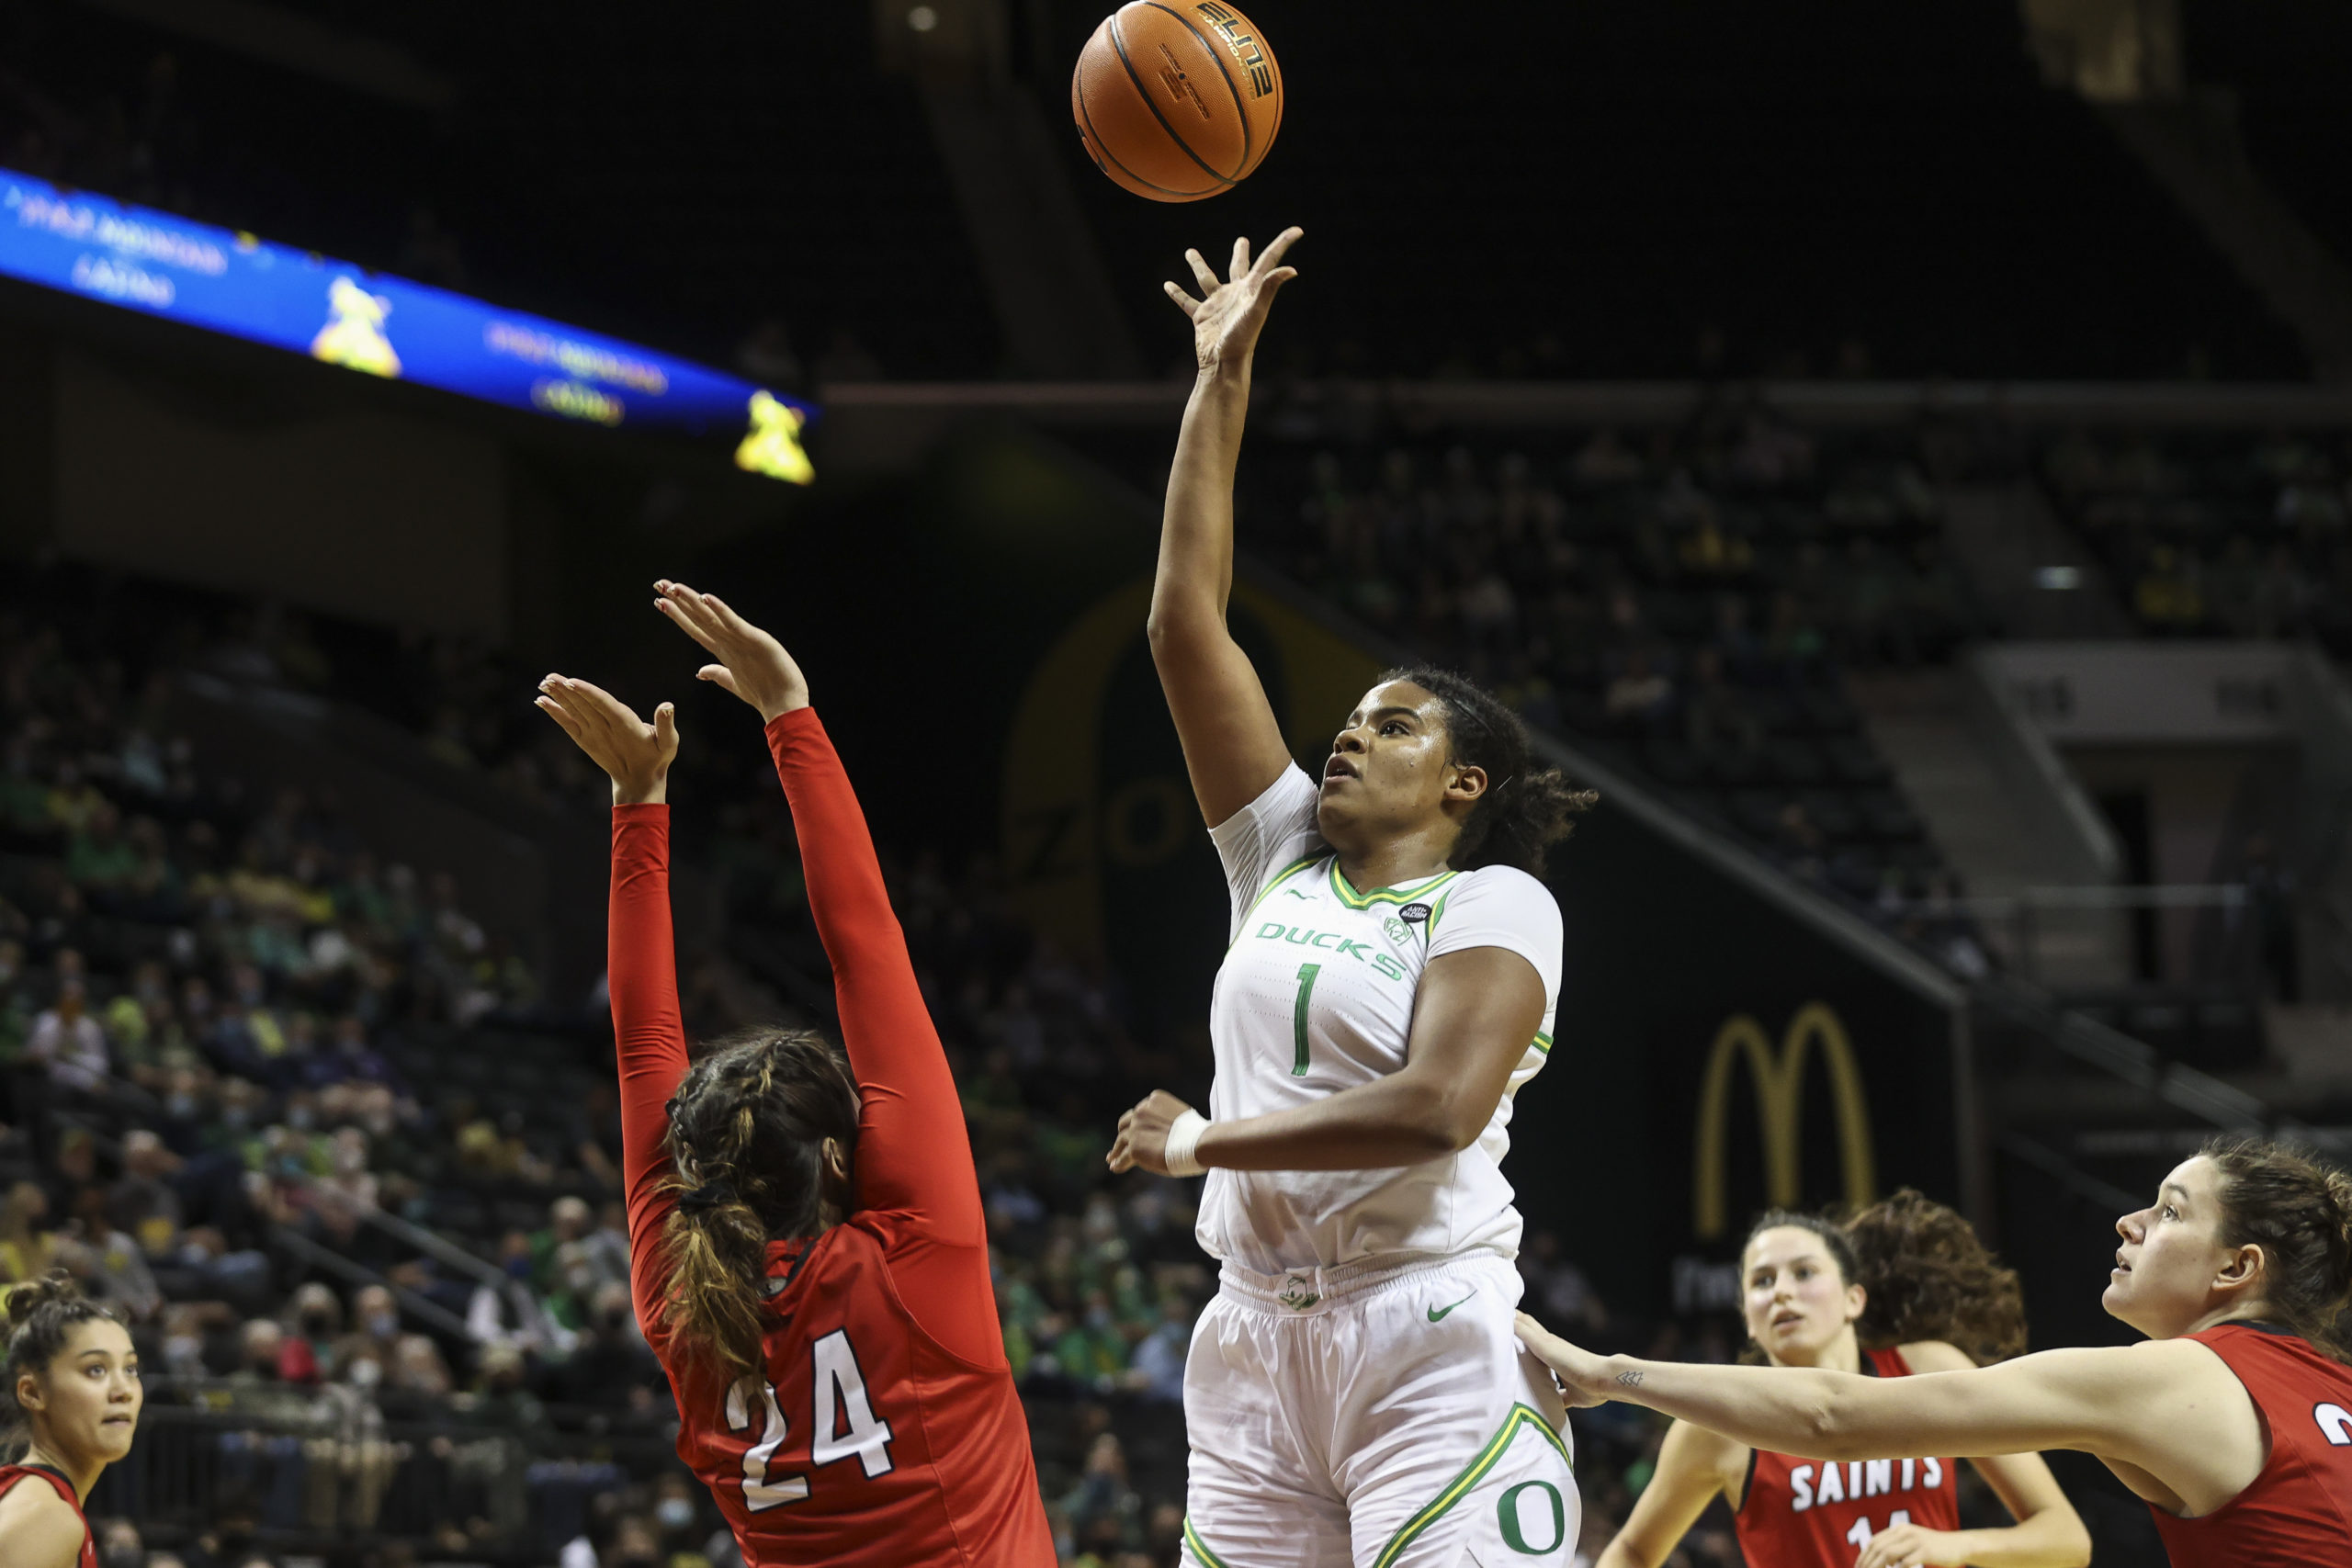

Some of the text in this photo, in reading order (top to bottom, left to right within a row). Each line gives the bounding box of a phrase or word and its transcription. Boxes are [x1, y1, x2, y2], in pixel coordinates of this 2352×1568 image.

[1196, 1, 1273, 98] ELITE
[1255, 922, 1407, 982] DUCKS
[1291, 963, 1321, 1077] 1
[724, 1325, 896, 1514] 24
[1497, 1481, 1565, 1555] O
[1791, 1456, 1943, 1513] SAINTS
